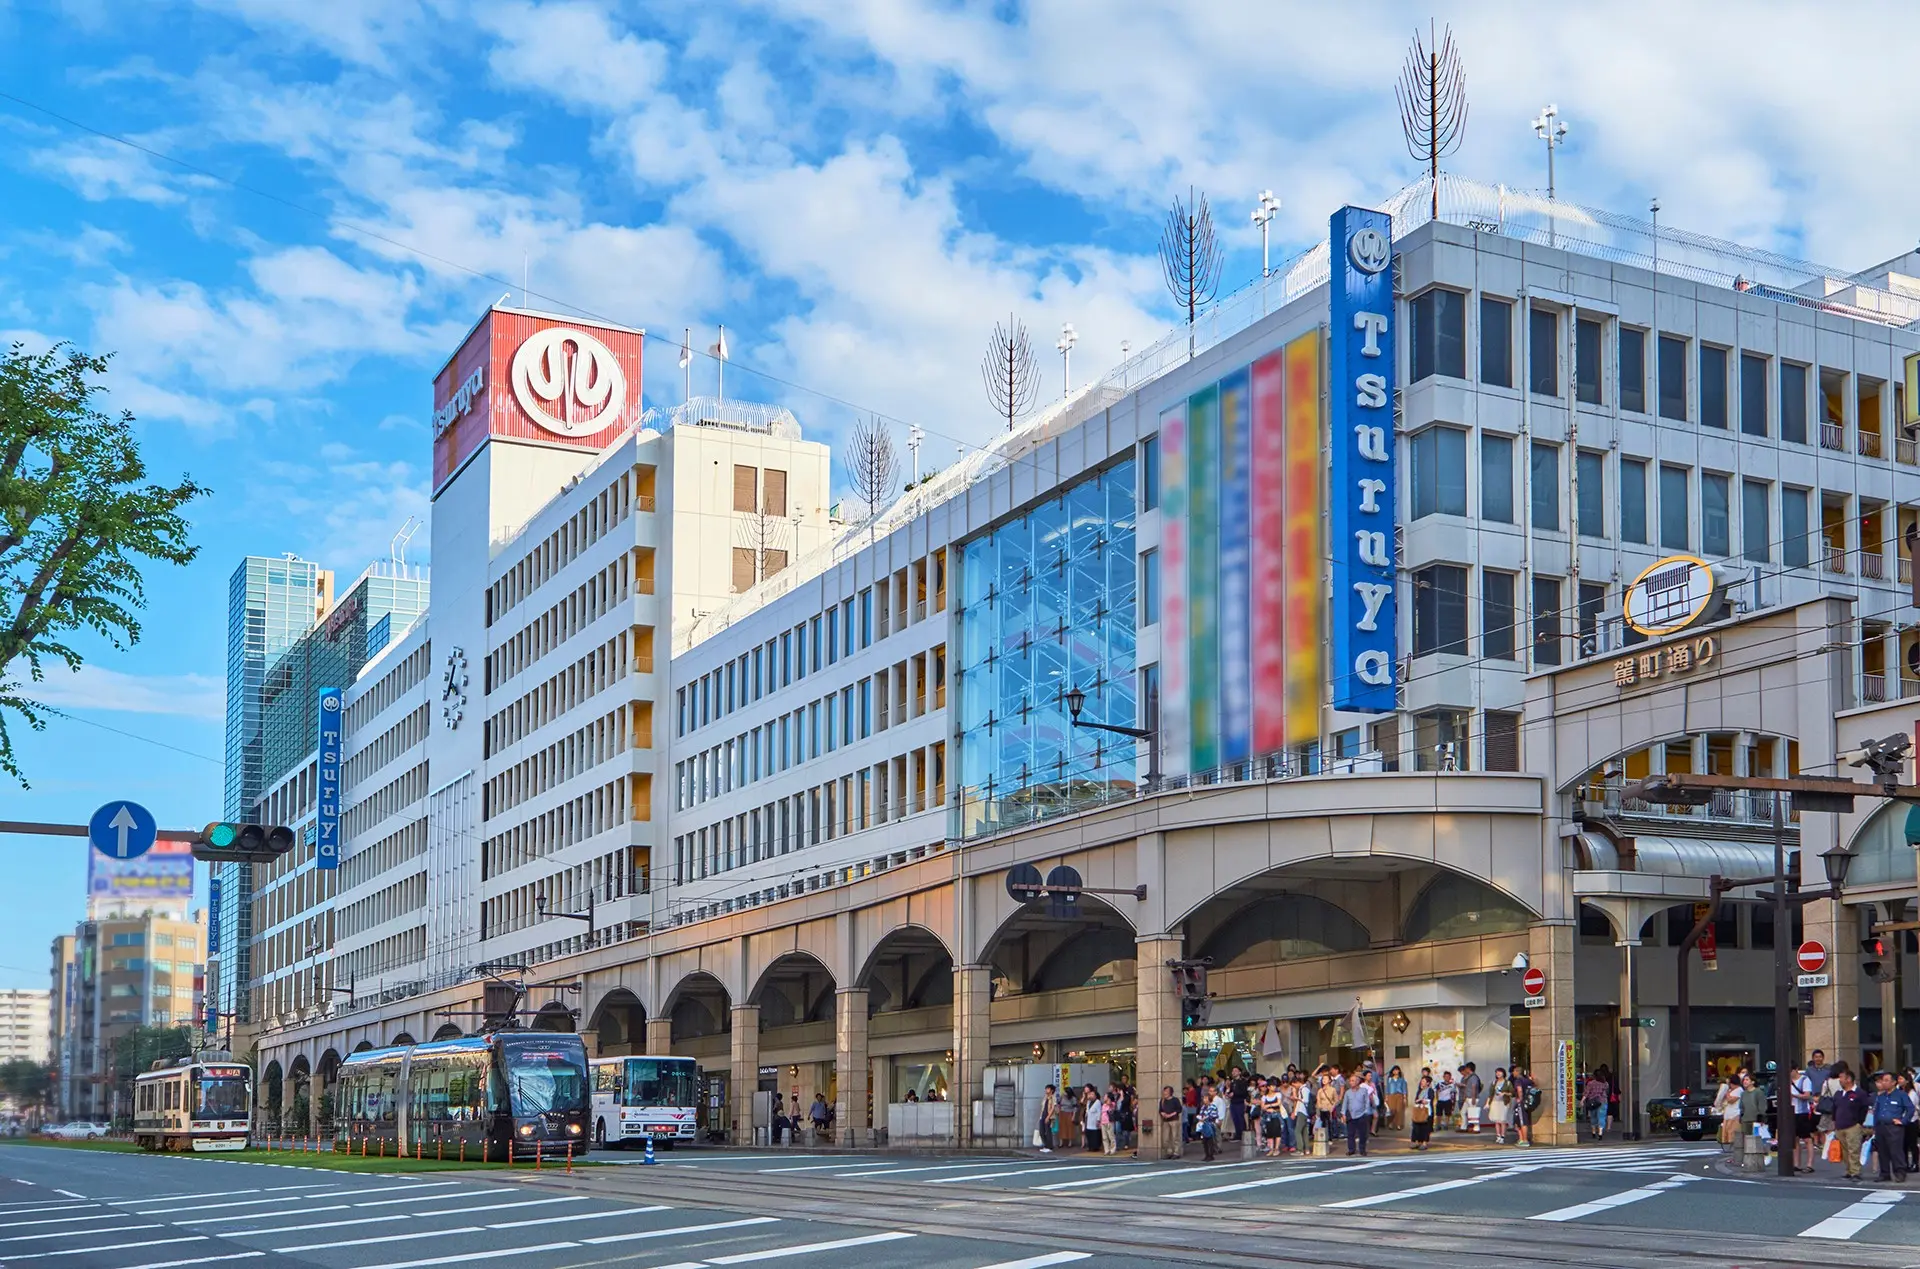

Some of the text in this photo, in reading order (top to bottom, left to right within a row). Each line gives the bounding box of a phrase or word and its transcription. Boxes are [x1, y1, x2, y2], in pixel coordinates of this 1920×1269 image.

[1354, 310, 1392, 685] Tsuruya
[1613, 637, 1713, 687] 駕町通り
[321, 731, 338, 857] Tsuruya
[211, 899, 219, 947] Tsuruya
